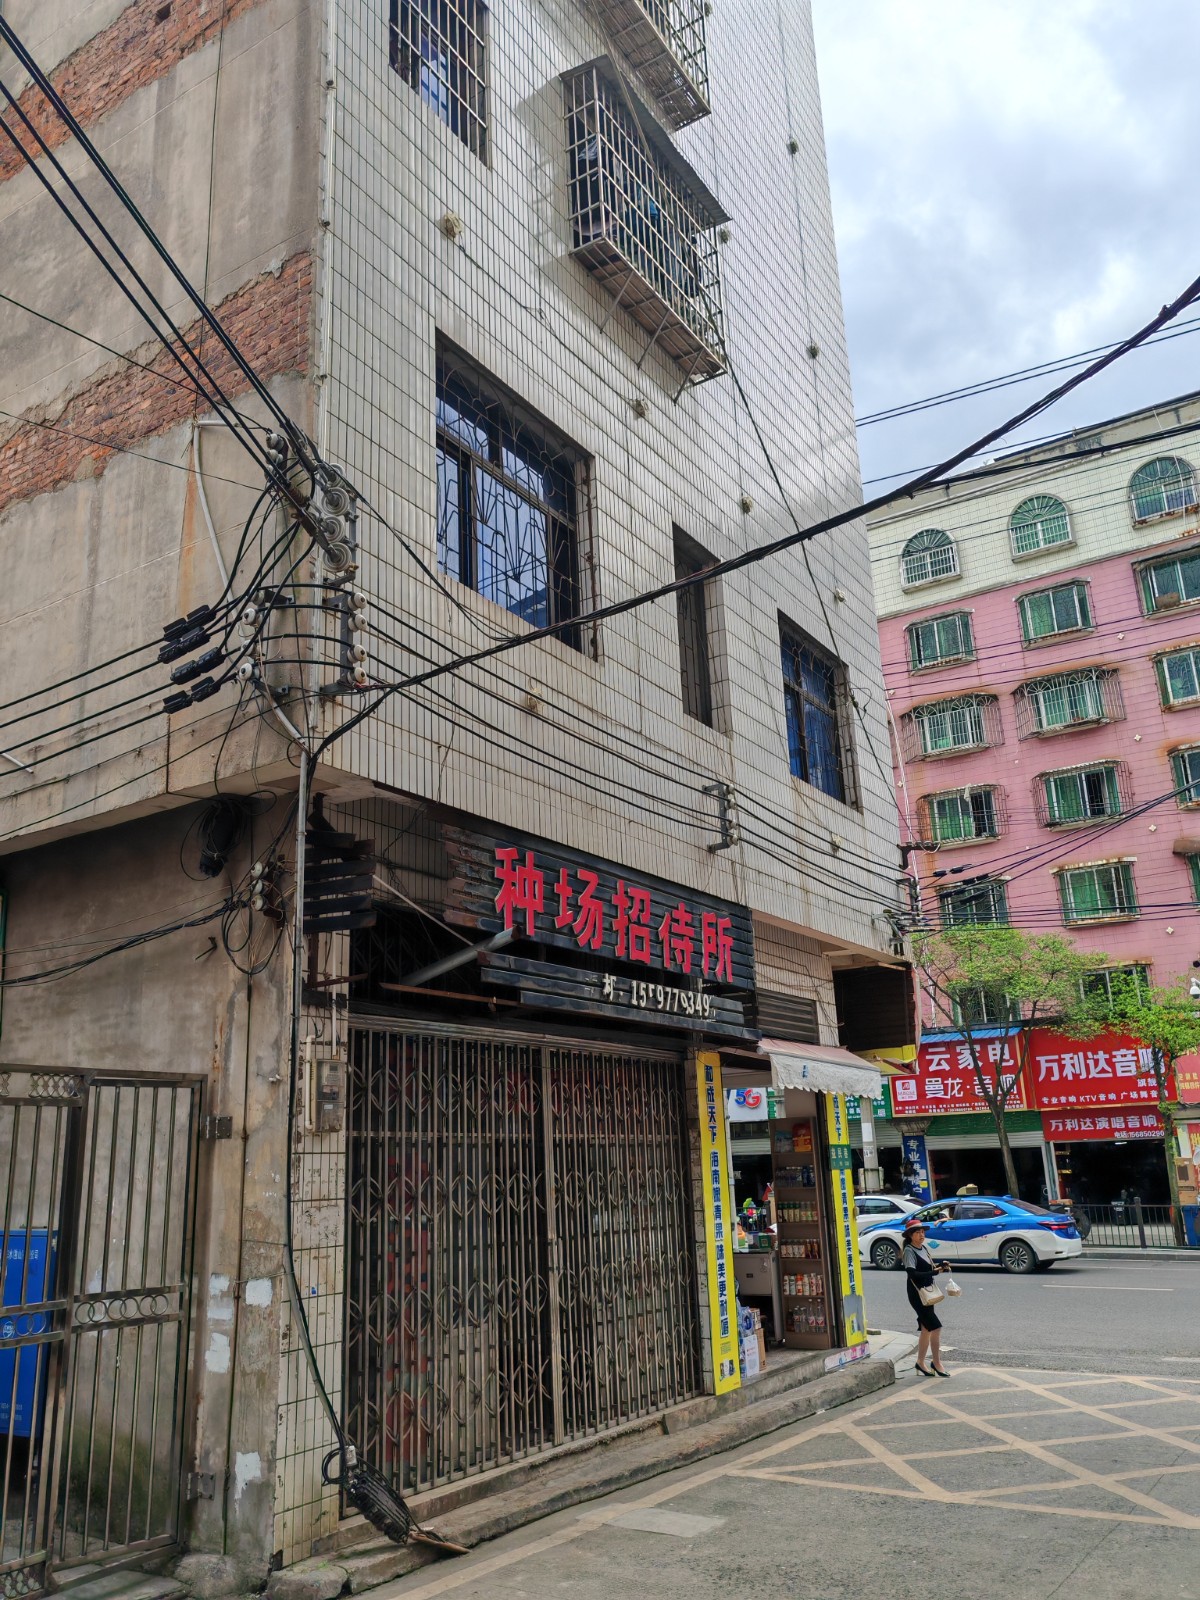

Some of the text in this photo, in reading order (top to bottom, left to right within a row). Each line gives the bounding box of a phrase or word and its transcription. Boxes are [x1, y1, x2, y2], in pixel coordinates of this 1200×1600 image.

[494, 847, 734, 983] 种场招待所
[1035, 1048, 1166, 1083] 万利达音响
[1137, 1077, 1167, 1087] 旗舰
[735, 1088, 761, 1108] 5G
[1050, 1114, 1157, 1132] 万利达演唱音响
